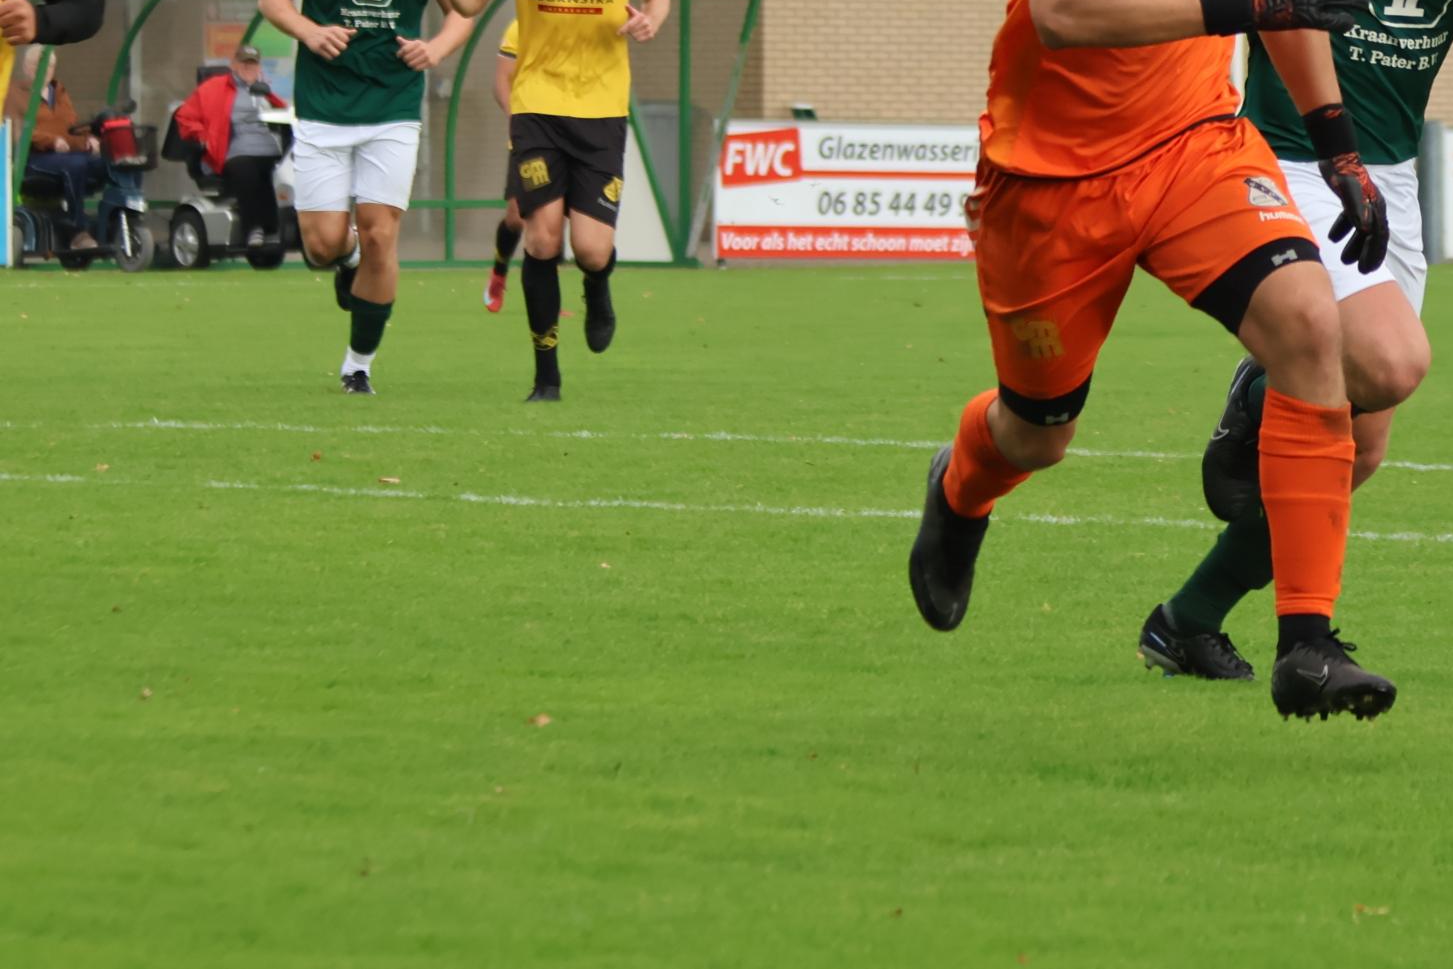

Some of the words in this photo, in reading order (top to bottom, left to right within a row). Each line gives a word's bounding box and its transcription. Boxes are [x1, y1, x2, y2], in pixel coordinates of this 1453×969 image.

[1349, 46, 1366, 62] T.
[1370, 50, 1416, 70] Pater
[724, 142, 795, 176] FWC
[818, 136, 978, 162] Glazenwasseri
[818, 191, 847, 216] 06
[853, 192, 881, 216] 85
[888, 193, 917, 217] 44
[923, 193, 951, 217] 49
[721, 231, 758, 250] Voor
[761, 232, 784, 251] als
[787, 232, 813, 251] het
[816, 233, 848, 251] echt
[852, 234, 902, 252] schoon
[909, 235, 948, 251] moet
